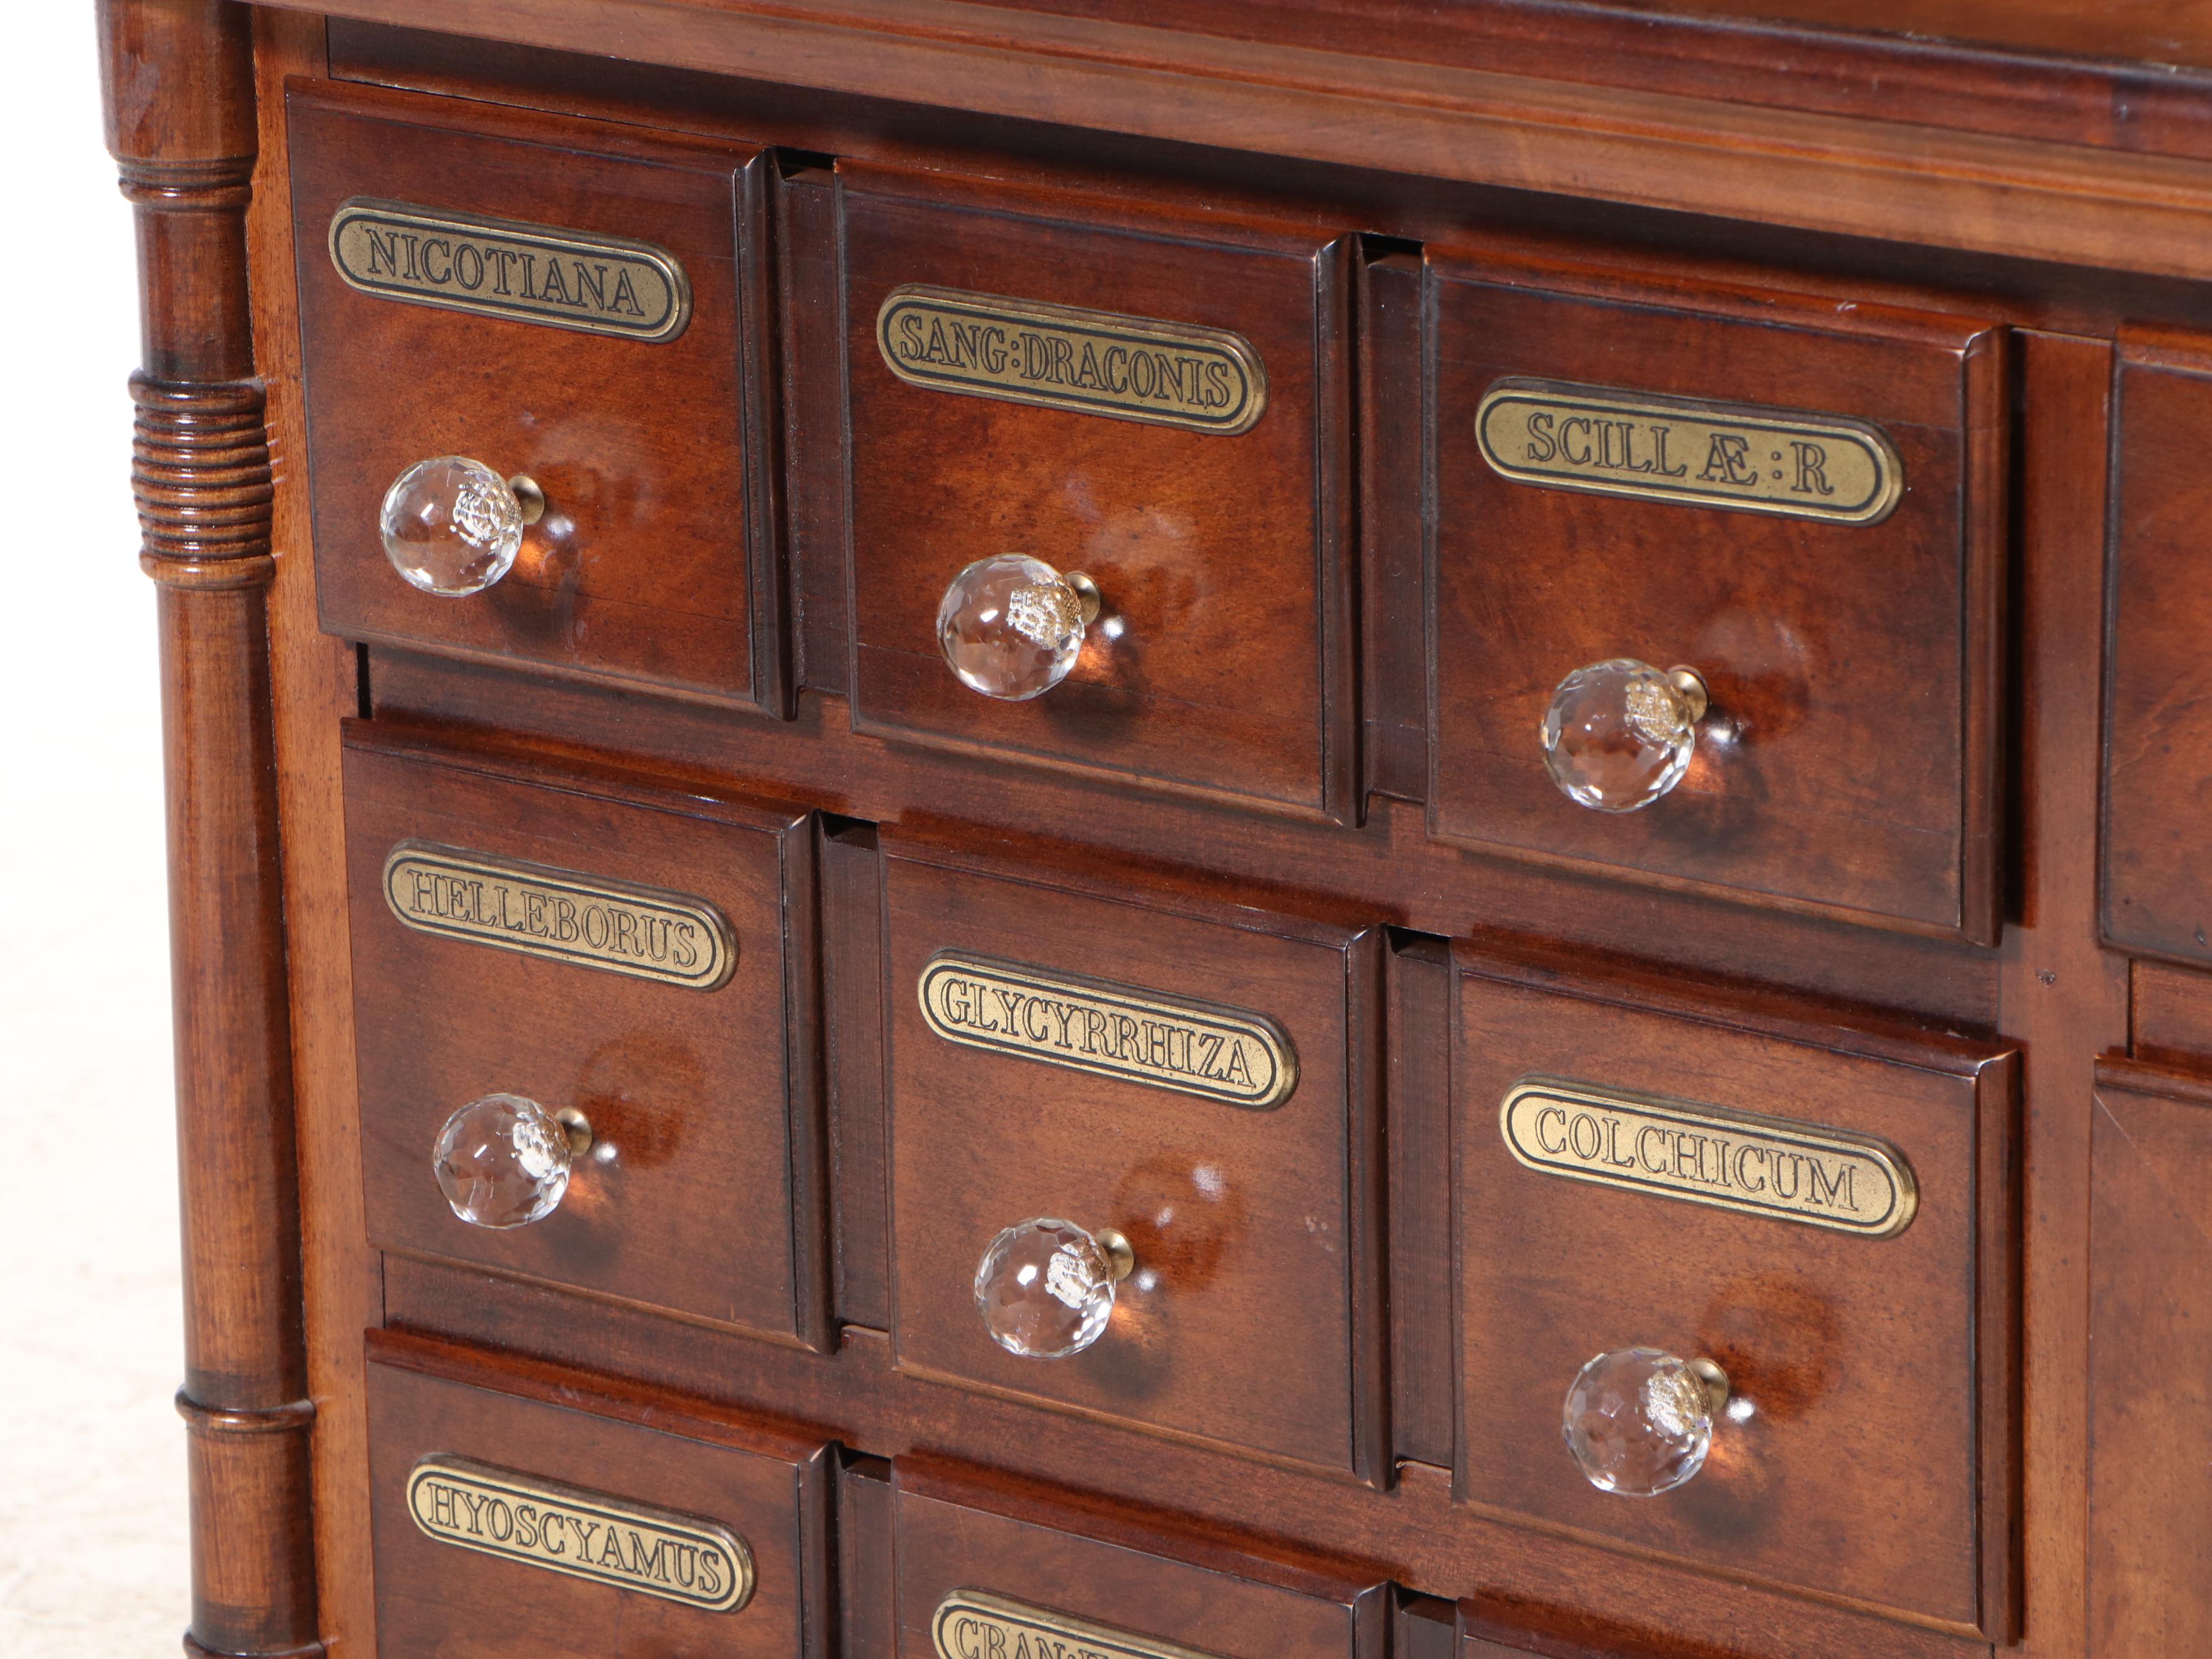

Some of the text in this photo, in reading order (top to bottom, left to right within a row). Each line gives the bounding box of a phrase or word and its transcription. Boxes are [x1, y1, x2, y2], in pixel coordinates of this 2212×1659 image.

[365, 229, 645, 316] NICOTIANA
[407, 869, 697, 967] HELLEBORUS
[940, 978, 1257, 1089] GLYCYRRHIZA
[1534, 1107, 1859, 1212] COLCHICUM
[427, 1482, 722, 1593] HYOSCYAMUS
